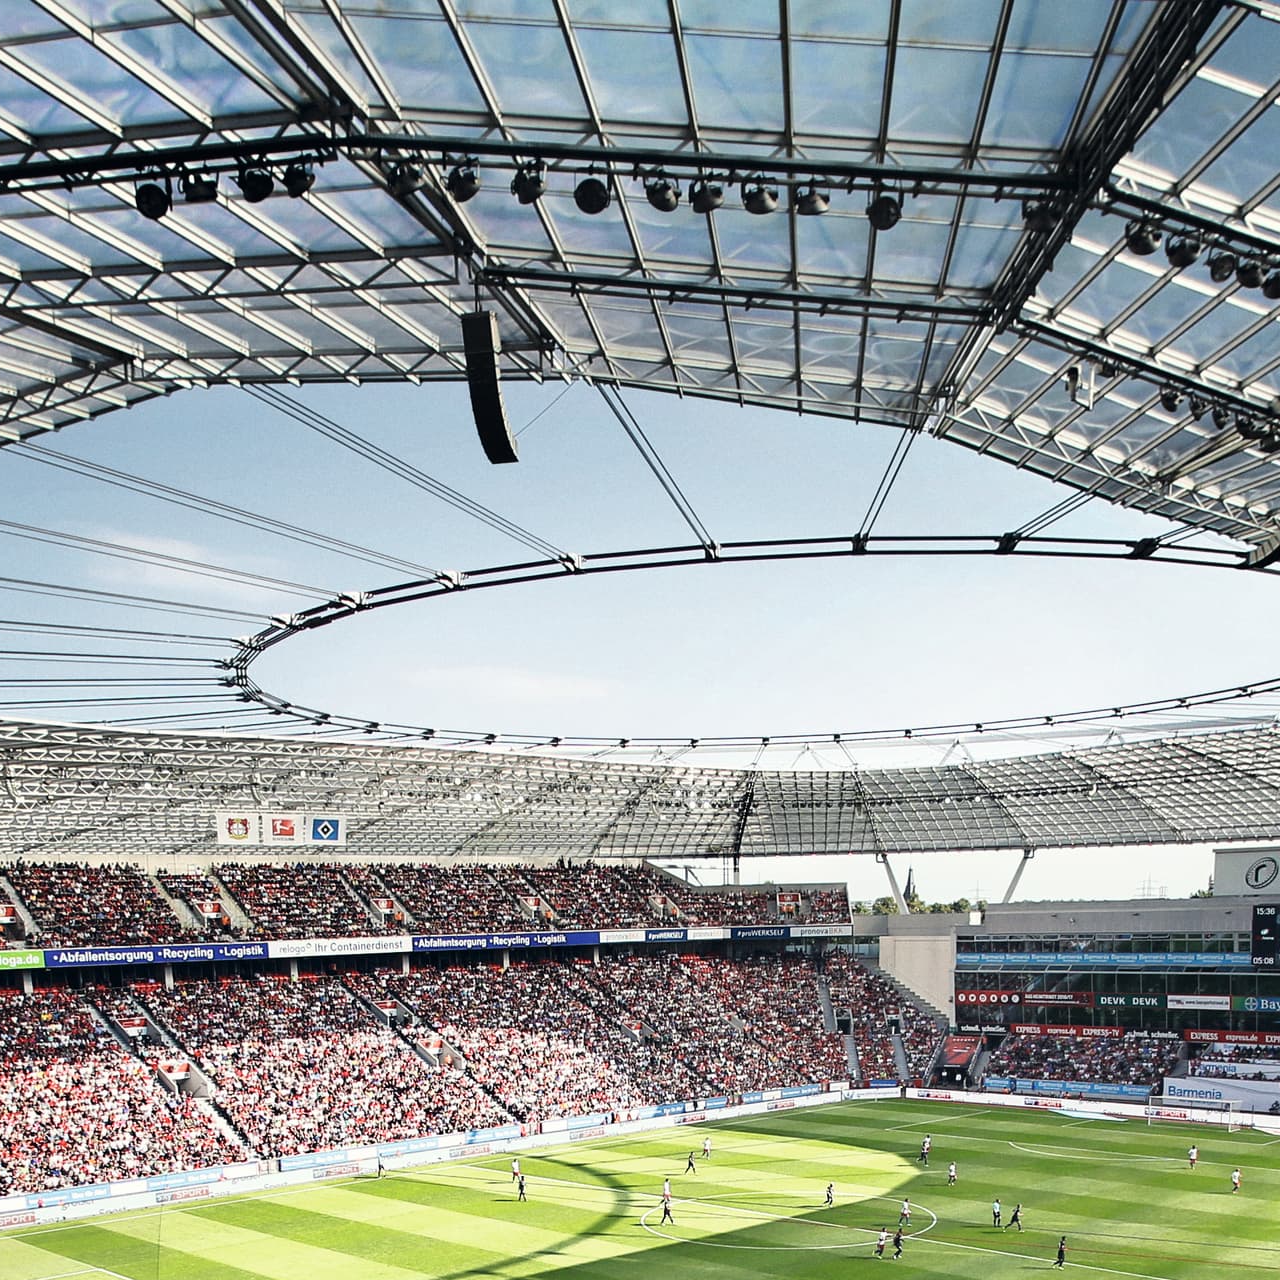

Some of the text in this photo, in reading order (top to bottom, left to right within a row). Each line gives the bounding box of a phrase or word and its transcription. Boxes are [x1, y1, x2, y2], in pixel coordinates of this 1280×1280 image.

[314, 942, 327, 953] Ihr
[330, 940, 403, 953] Containerdienst
[418, 933, 566, 950] Abfallentsorgung Recycling Logistik
[58, 945, 264, 963] Abfallentsorgung Recycling Logistik
[1100, 996, 1126, 1006] DEVK
[1132, 997, 1158, 1007] DEVK
[1015, 1026, 1041, 1034] EXPRESS
[1190, 1031, 1219, 1041] EXPRESS
[1198, 1062, 1237, 1073] armenia
[1168, 1085, 1222, 1100] Barmenia
